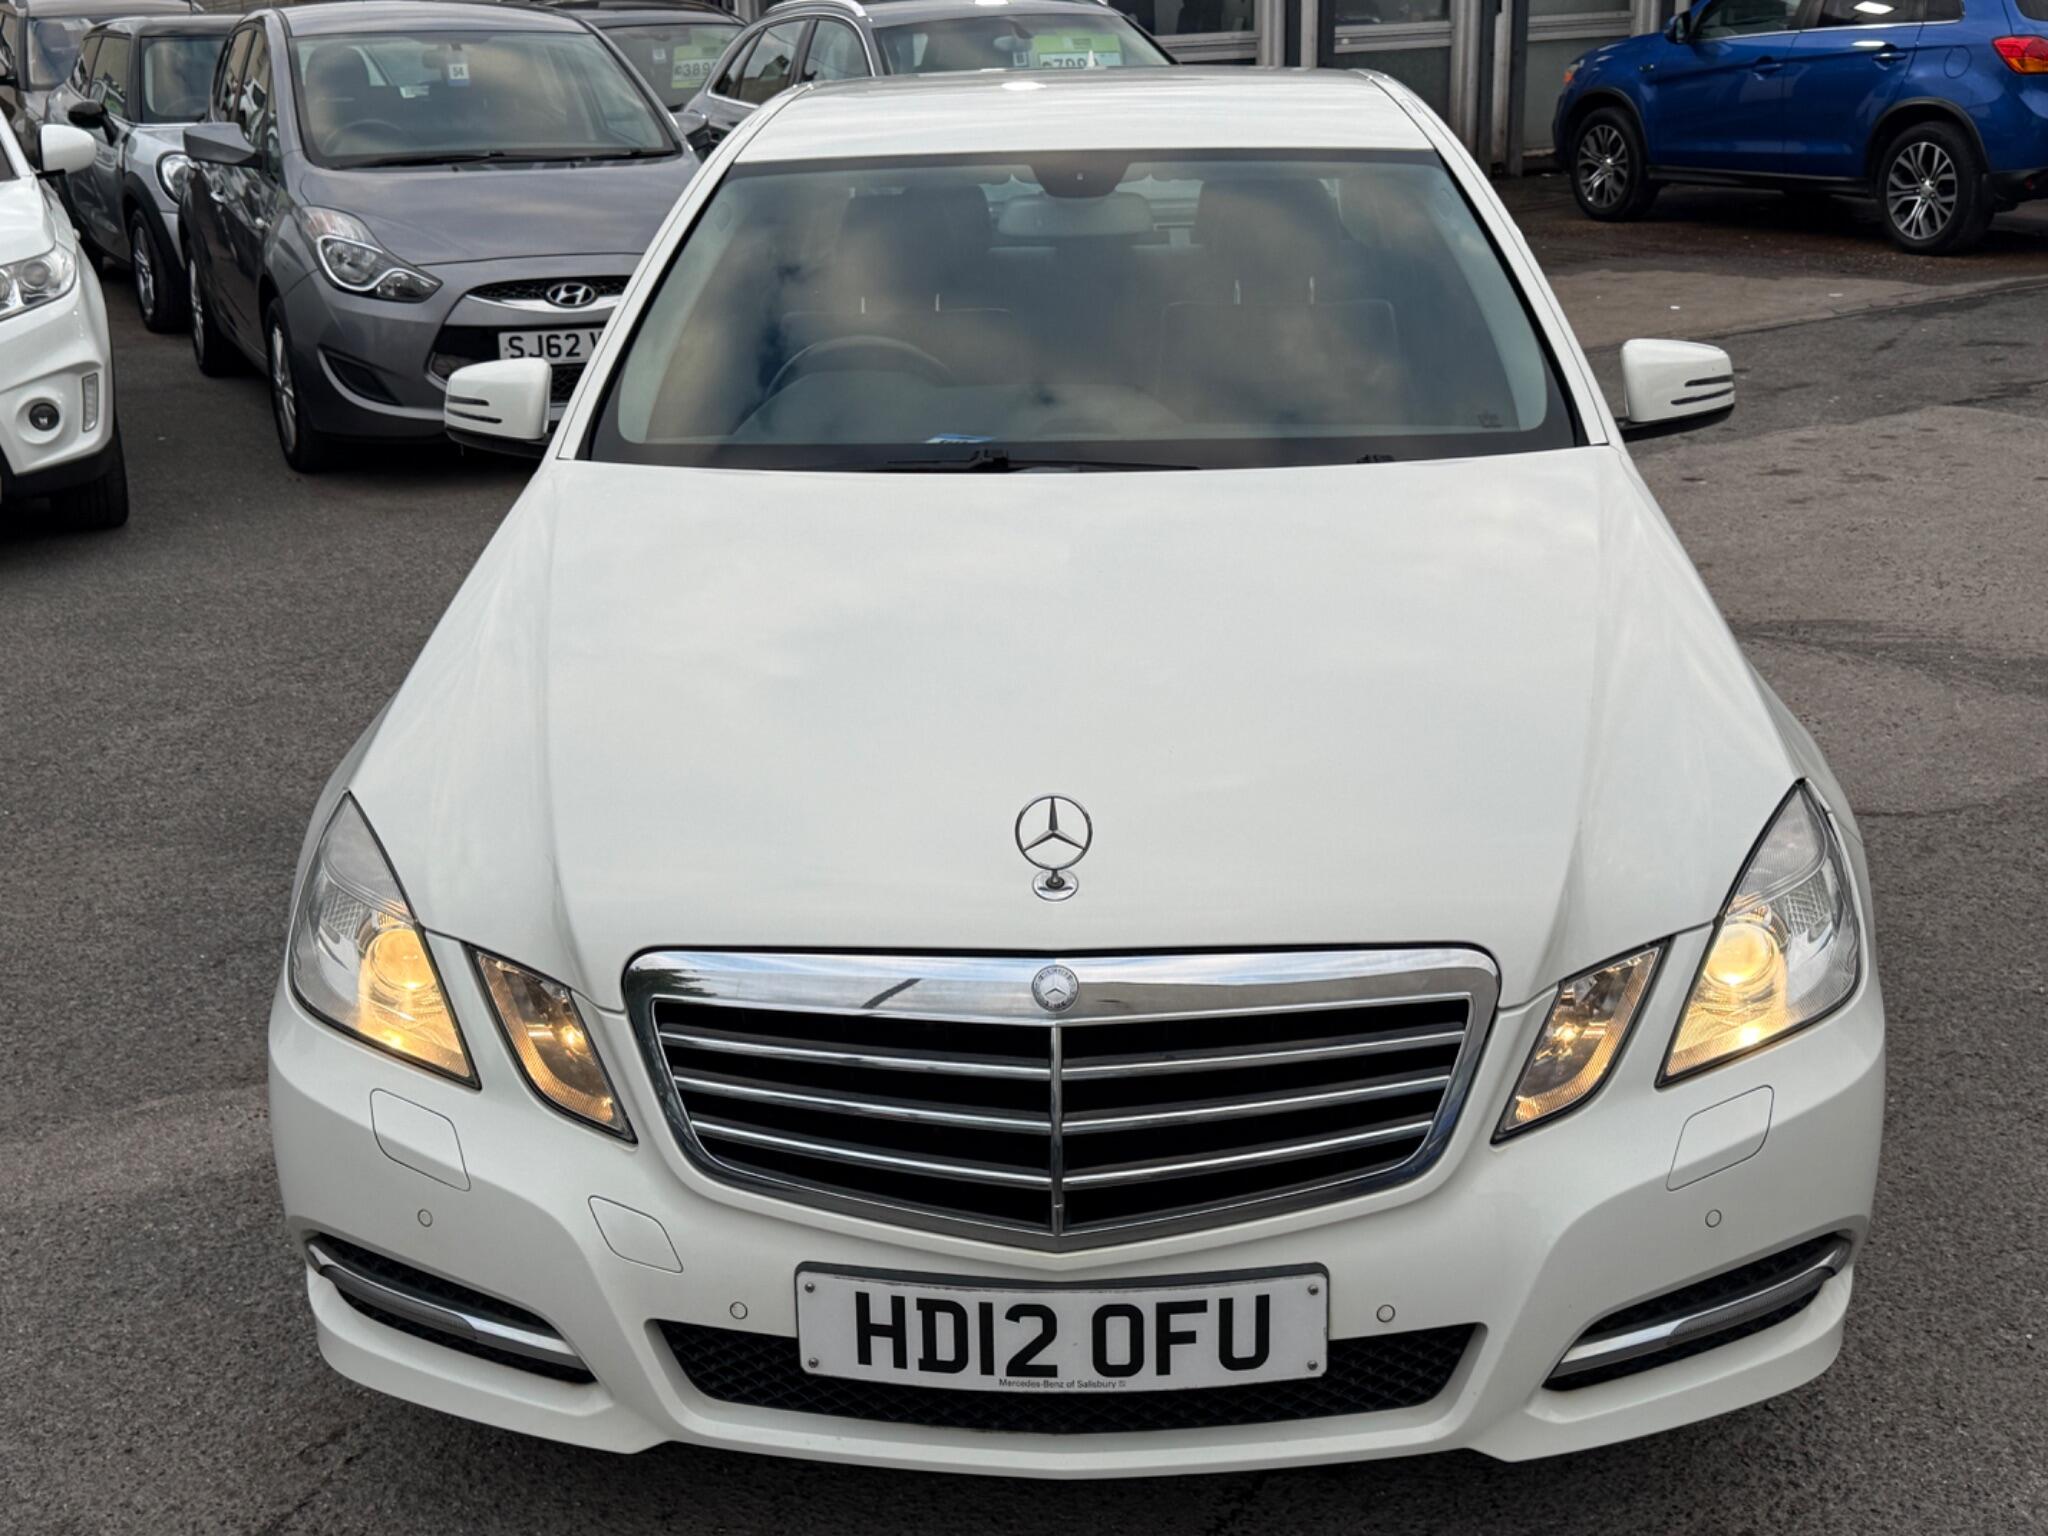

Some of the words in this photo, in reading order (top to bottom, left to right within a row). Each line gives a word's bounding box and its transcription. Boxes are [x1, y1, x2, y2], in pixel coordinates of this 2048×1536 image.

[507, 333, 581, 358] SJ62
[855, 1291, 1059, 1378] HD12
[1092, 1294, 1270, 1378] OFU
[999, 1378, 1064, 1389] Mercedes-Benz
[1066, 1379, 1075, 1389] of
[1077, 1379, 1117, 1389] Salisbury
